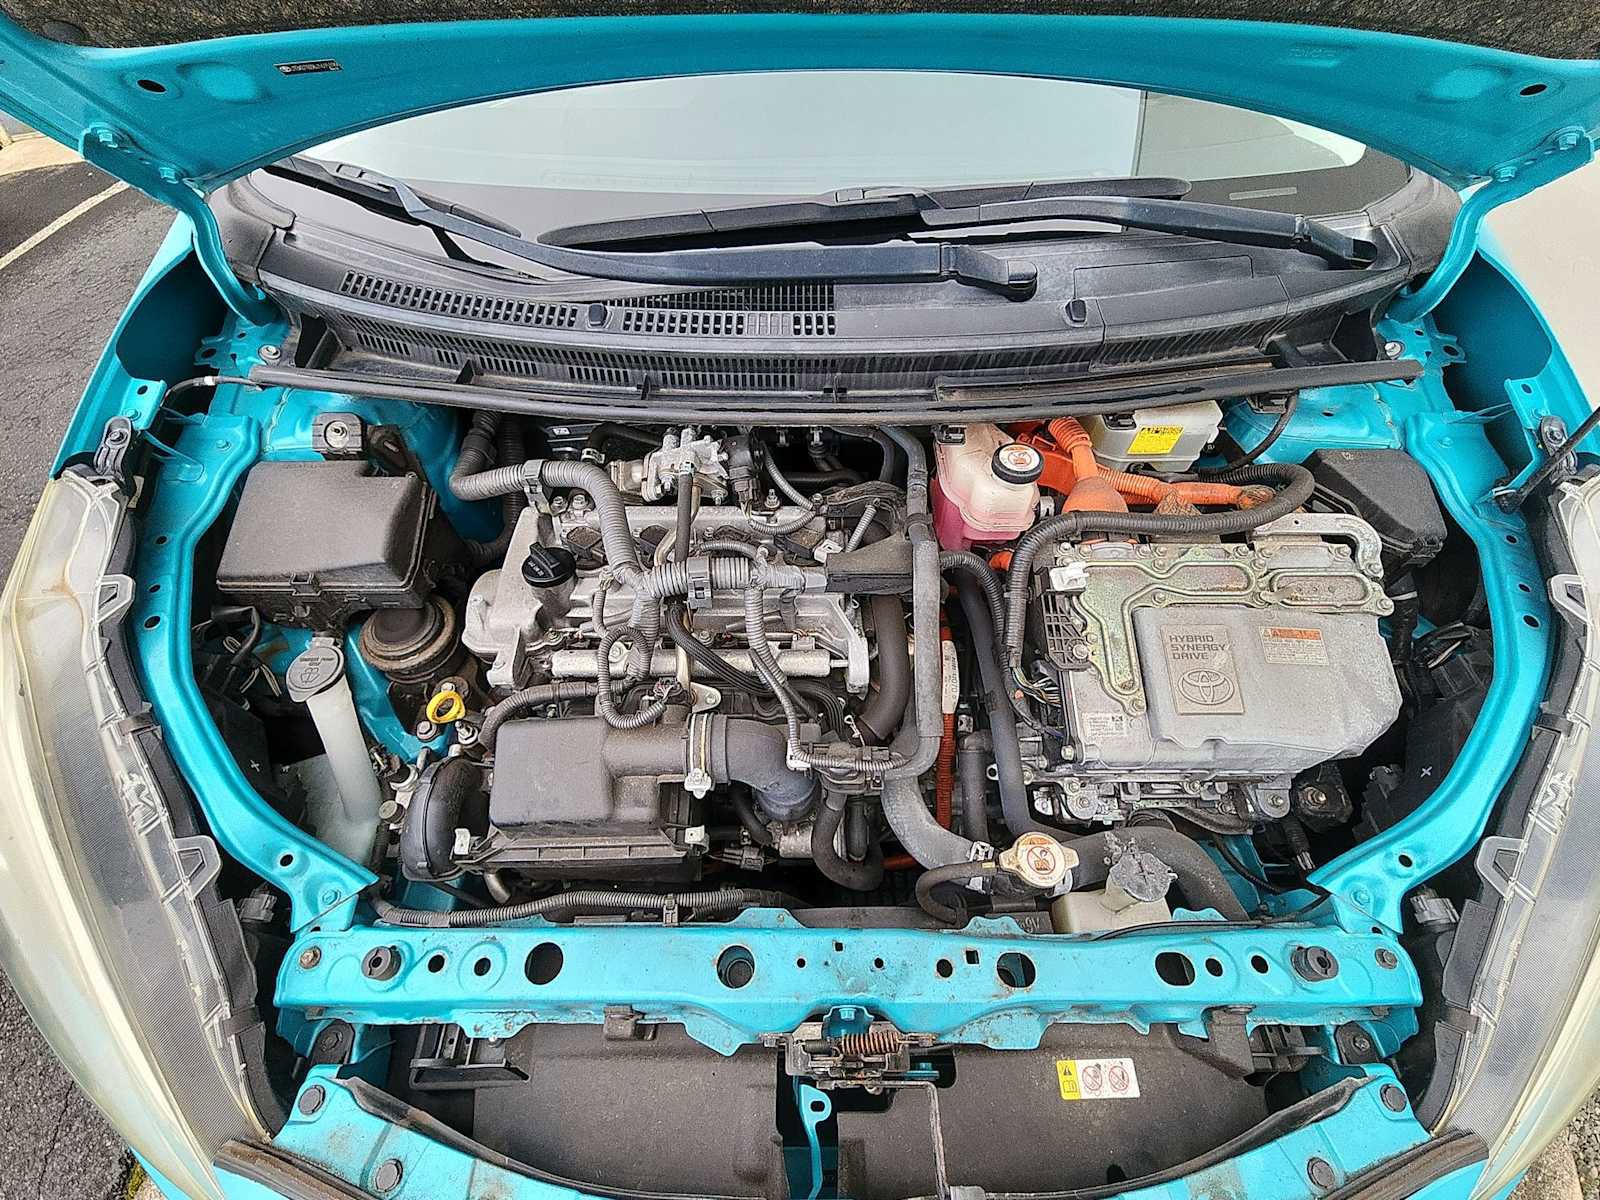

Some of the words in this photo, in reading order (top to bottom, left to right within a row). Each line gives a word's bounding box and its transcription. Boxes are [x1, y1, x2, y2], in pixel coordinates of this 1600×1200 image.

[1169, 634, 1214, 643] HYBRID
[1170, 643, 1226, 652] SYNERGY
[1172, 652, 1209, 660] DRIVE
